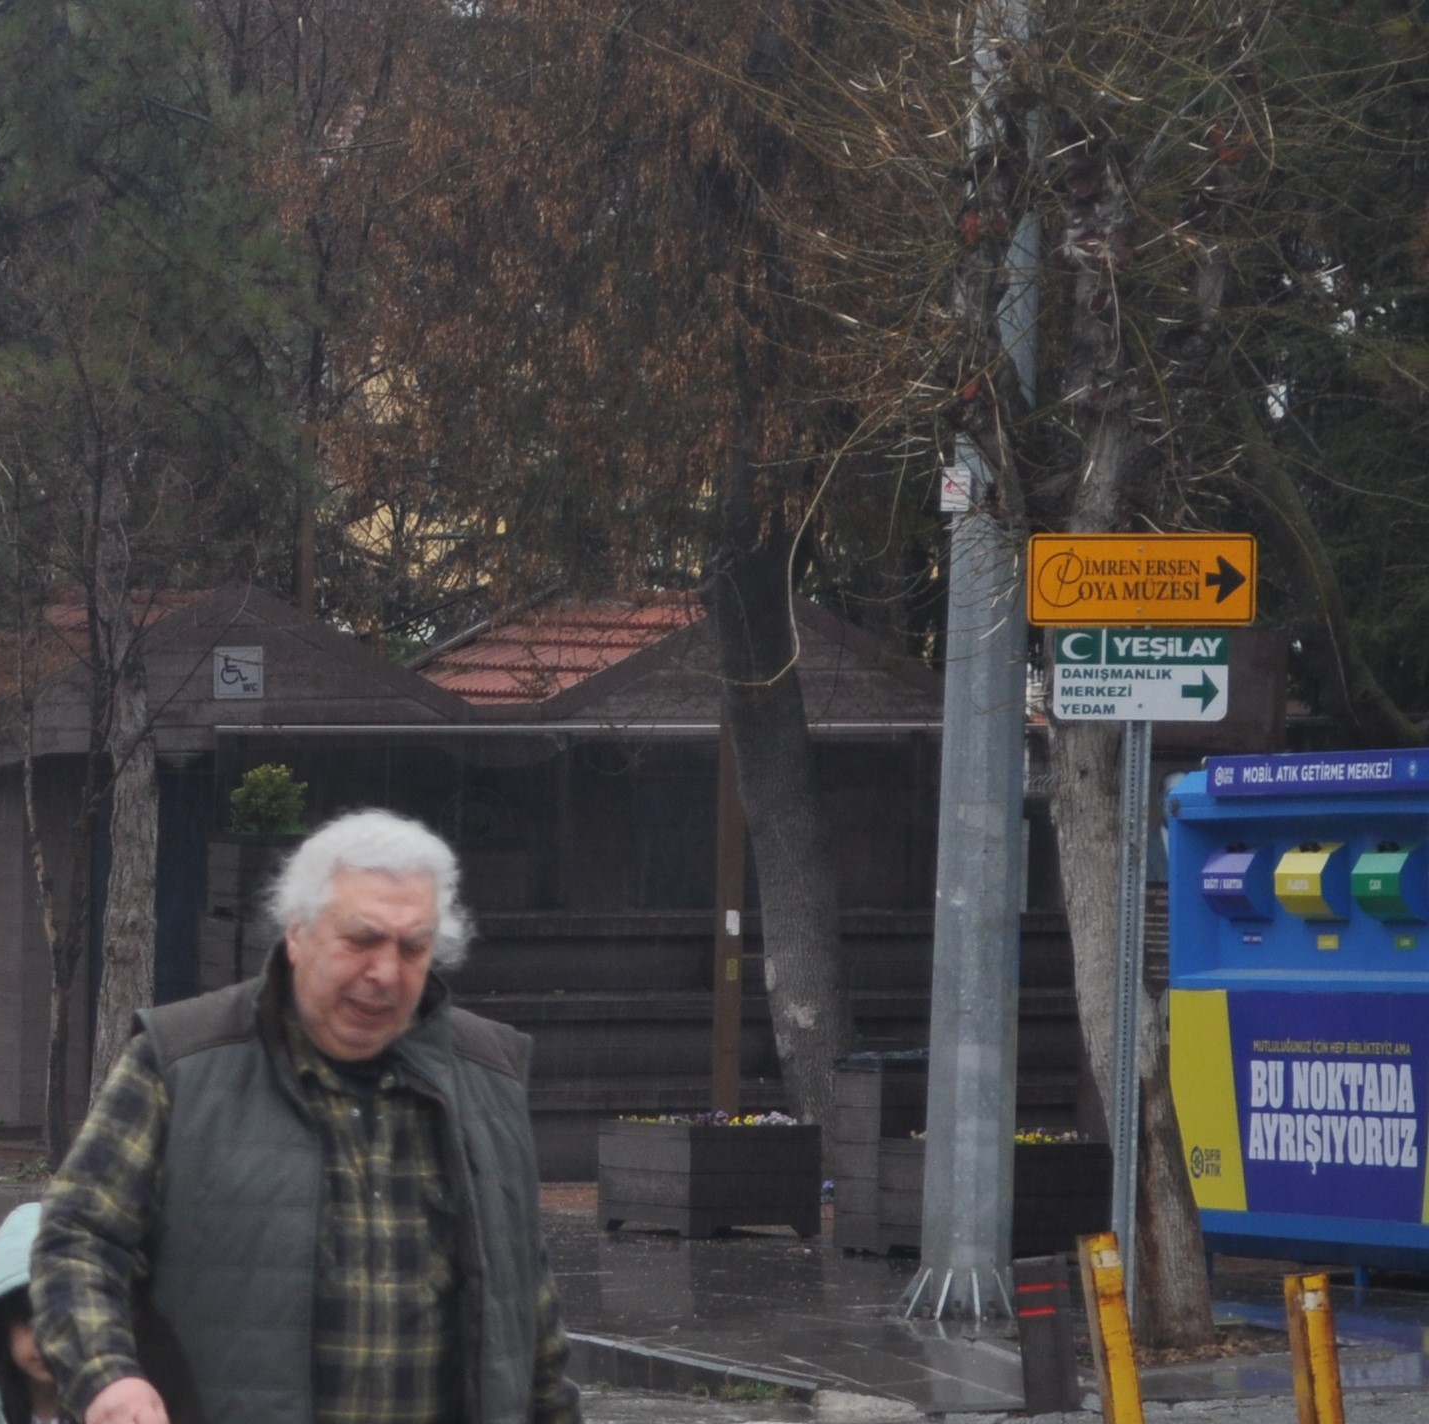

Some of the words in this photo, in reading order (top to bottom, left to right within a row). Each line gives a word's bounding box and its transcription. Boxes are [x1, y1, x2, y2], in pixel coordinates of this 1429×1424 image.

[1084, 557, 1141, 576] İMREN
[1145, 559, 1201, 579] ERŞEN
[1078, 581, 1118, 601] OYA
[1122, 577, 1201, 601] MÜZESİ
[1113, 636, 1223, 660] YEŞİLAY
[1061, 668, 1172, 682] DANIŞMANLIK
[242, 682, 258, 692] WC
[1061, 683, 1132, 697] MERKEZİ
[1060, 703, 1116, 715] YEDAM
[1242, 762, 1273, 783] MOBİL
[1276, 765, 1299, 782] ATIK
[1301, 760, 1345, 781] GETİRME
[1347, 758, 1393, 780] MERKEZİ
[1250, 1060, 1285, 1109] BU
[1292, 1060, 1416, 1113] NOKTADA
[1248, 1112, 1418, 1175] AYRIŞIYORUZ
